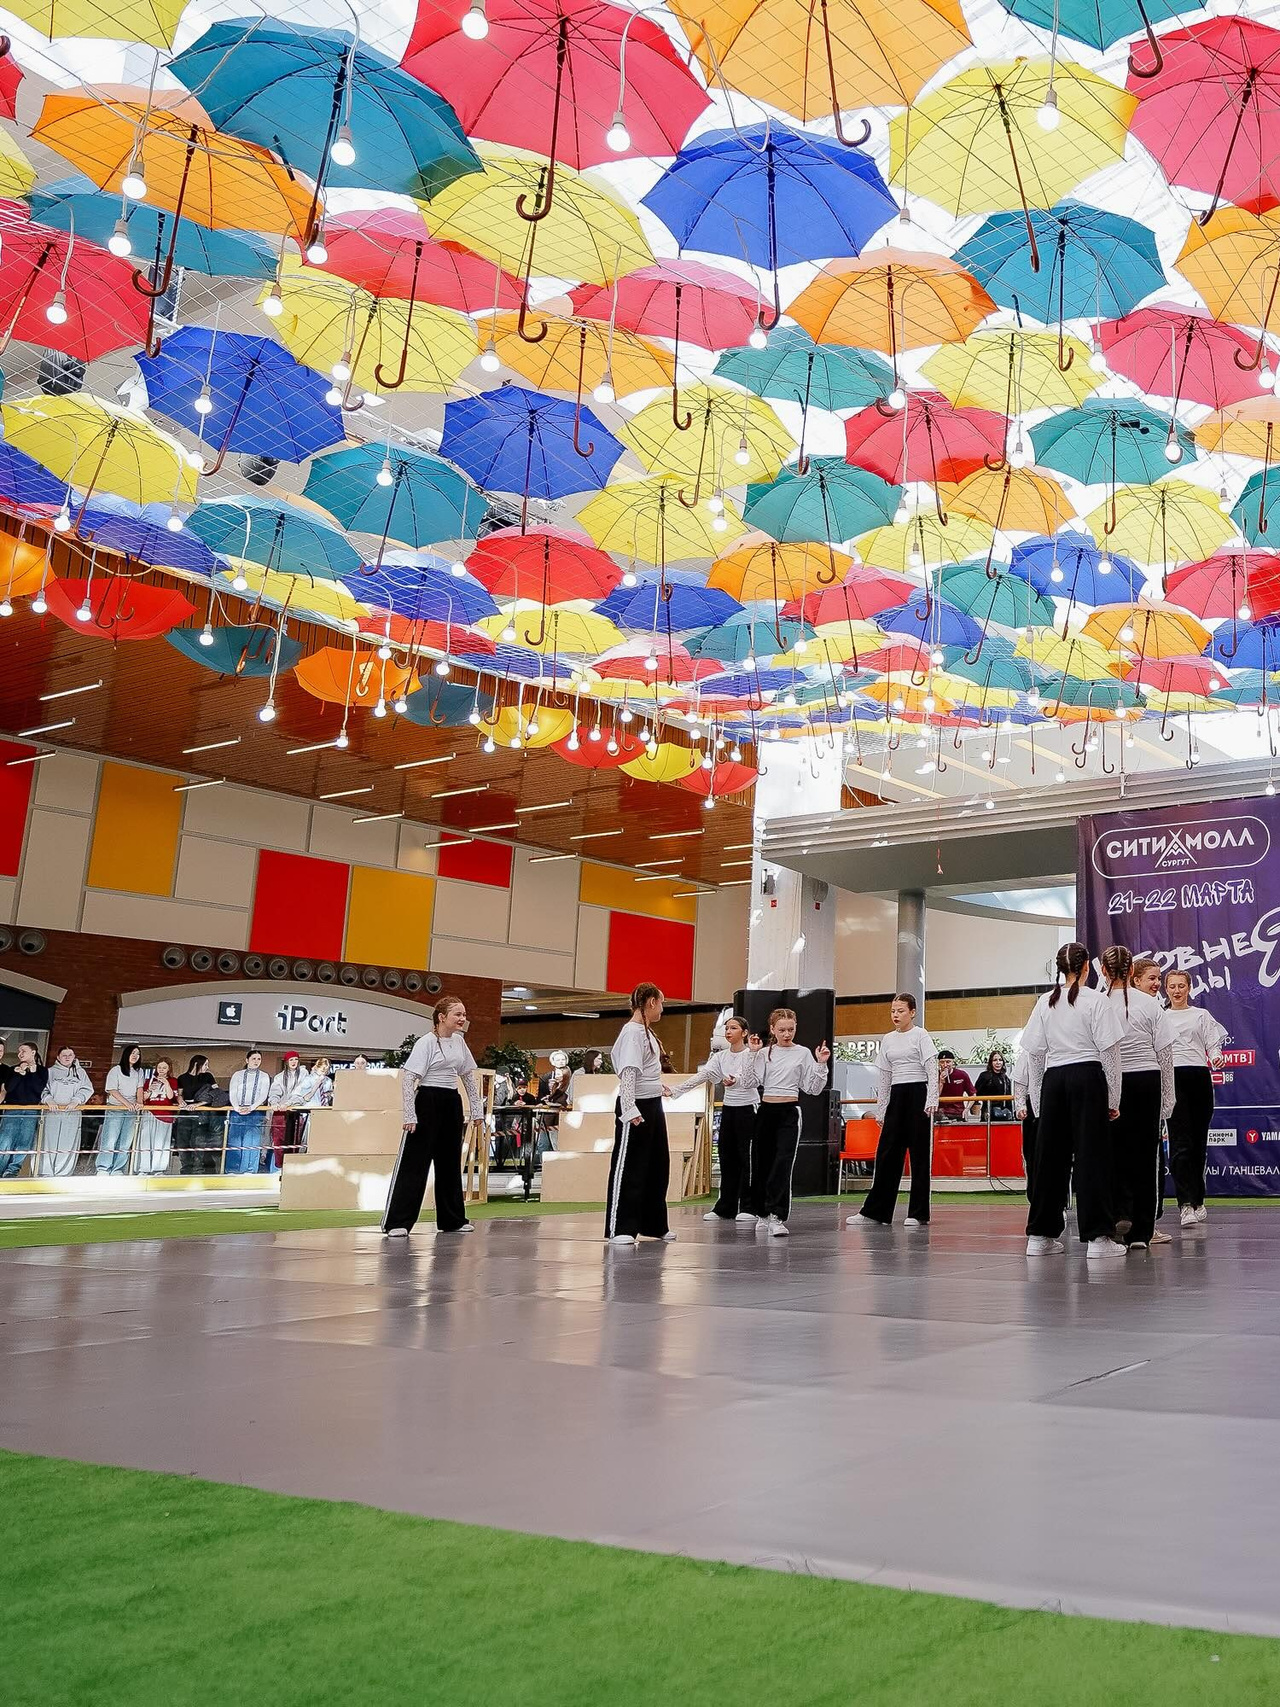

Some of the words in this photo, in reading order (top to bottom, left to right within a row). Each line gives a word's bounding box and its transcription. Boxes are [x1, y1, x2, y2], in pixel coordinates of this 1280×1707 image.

[1106, 835, 1167, 859] СИТИ
[1185, 828, 1255, 850] МОЛЛ
[1162, 858, 1190, 867] СУРГУТ
[1107, 887, 1178, 915] 21-22
[1181, 878, 1255, 909] МАРТА
[277, 1004, 348, 1034] iPort
